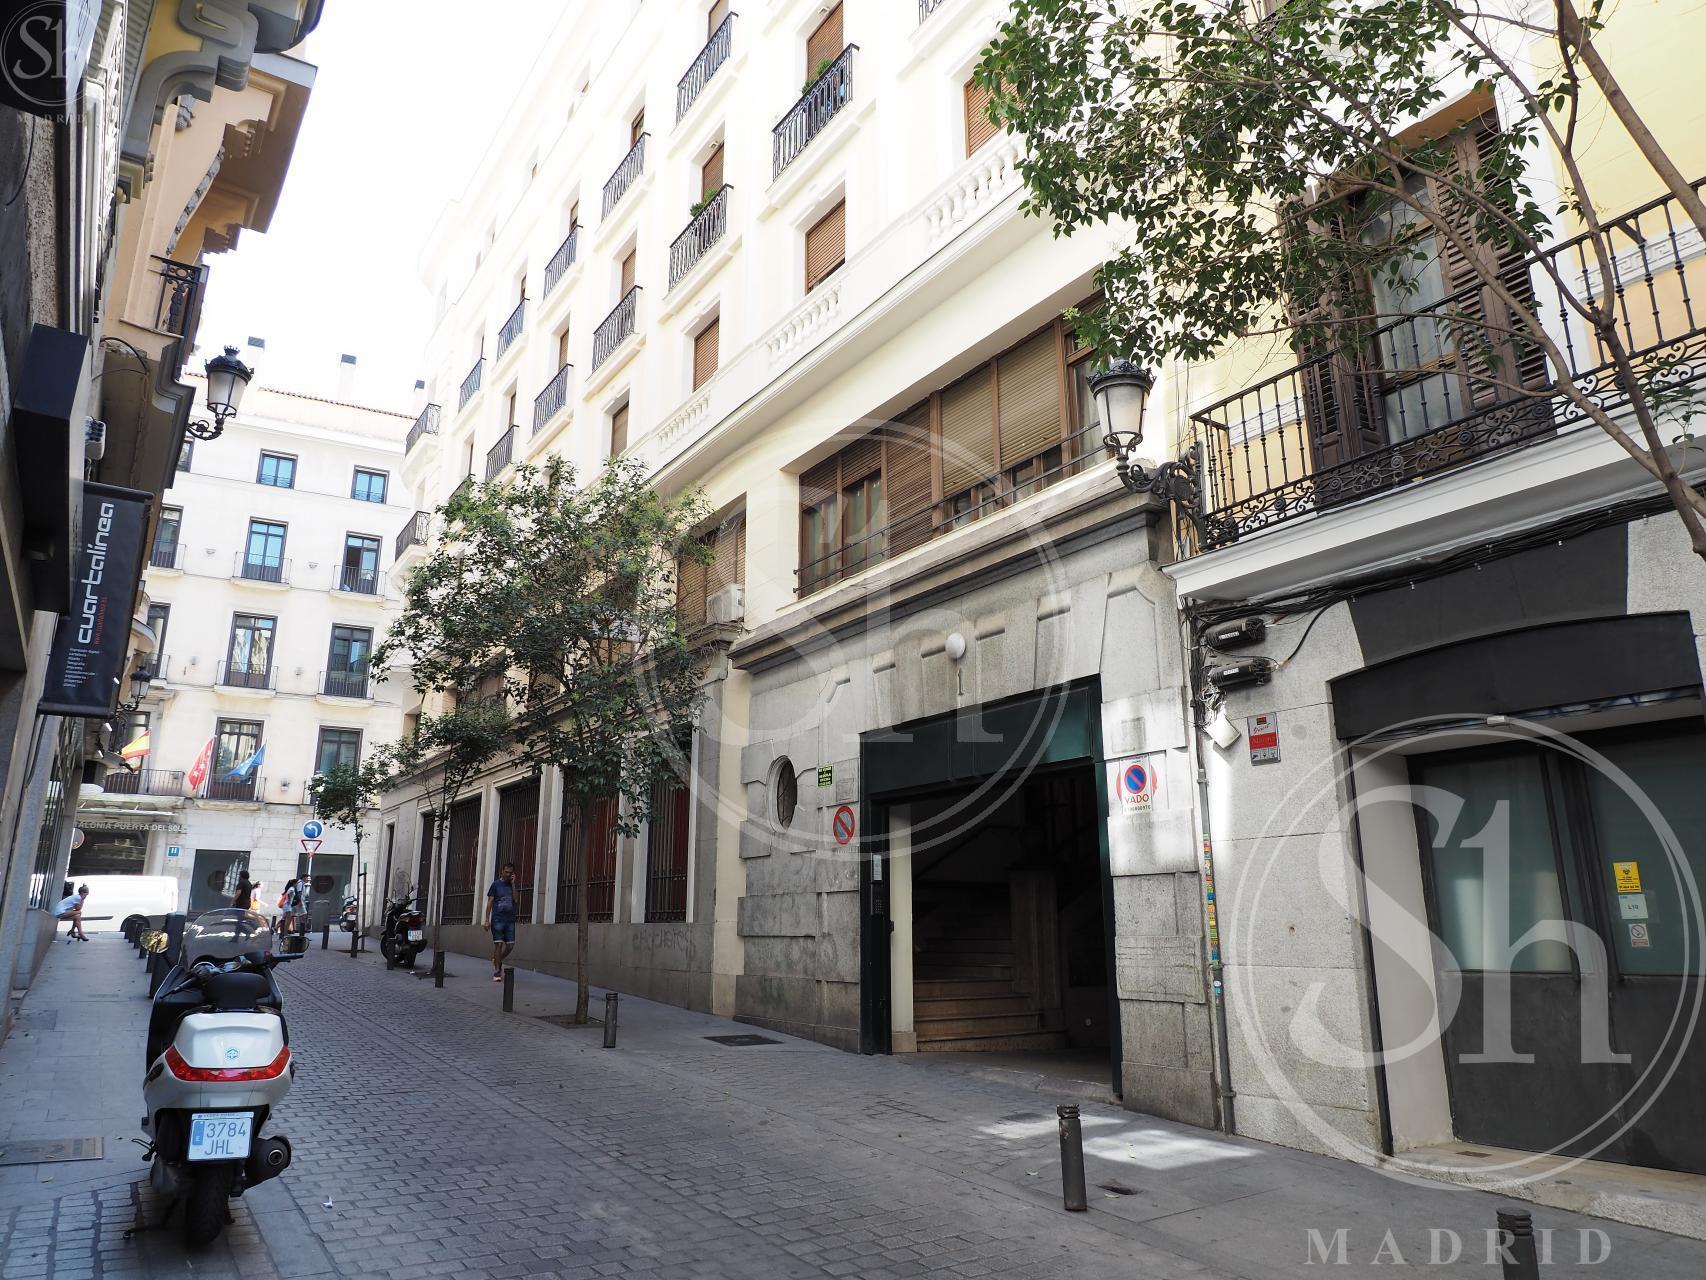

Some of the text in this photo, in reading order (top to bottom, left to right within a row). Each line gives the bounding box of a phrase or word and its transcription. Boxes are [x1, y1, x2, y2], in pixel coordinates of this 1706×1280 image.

[78, 502, 115, 644] cuartalínea
[1125, 793, 1150, 804] VADO
[114, 822, 150, 831] PUERTA
[206, 1121, 247, 1138] 3784
[204, 1139, 234, 1155] JHL
